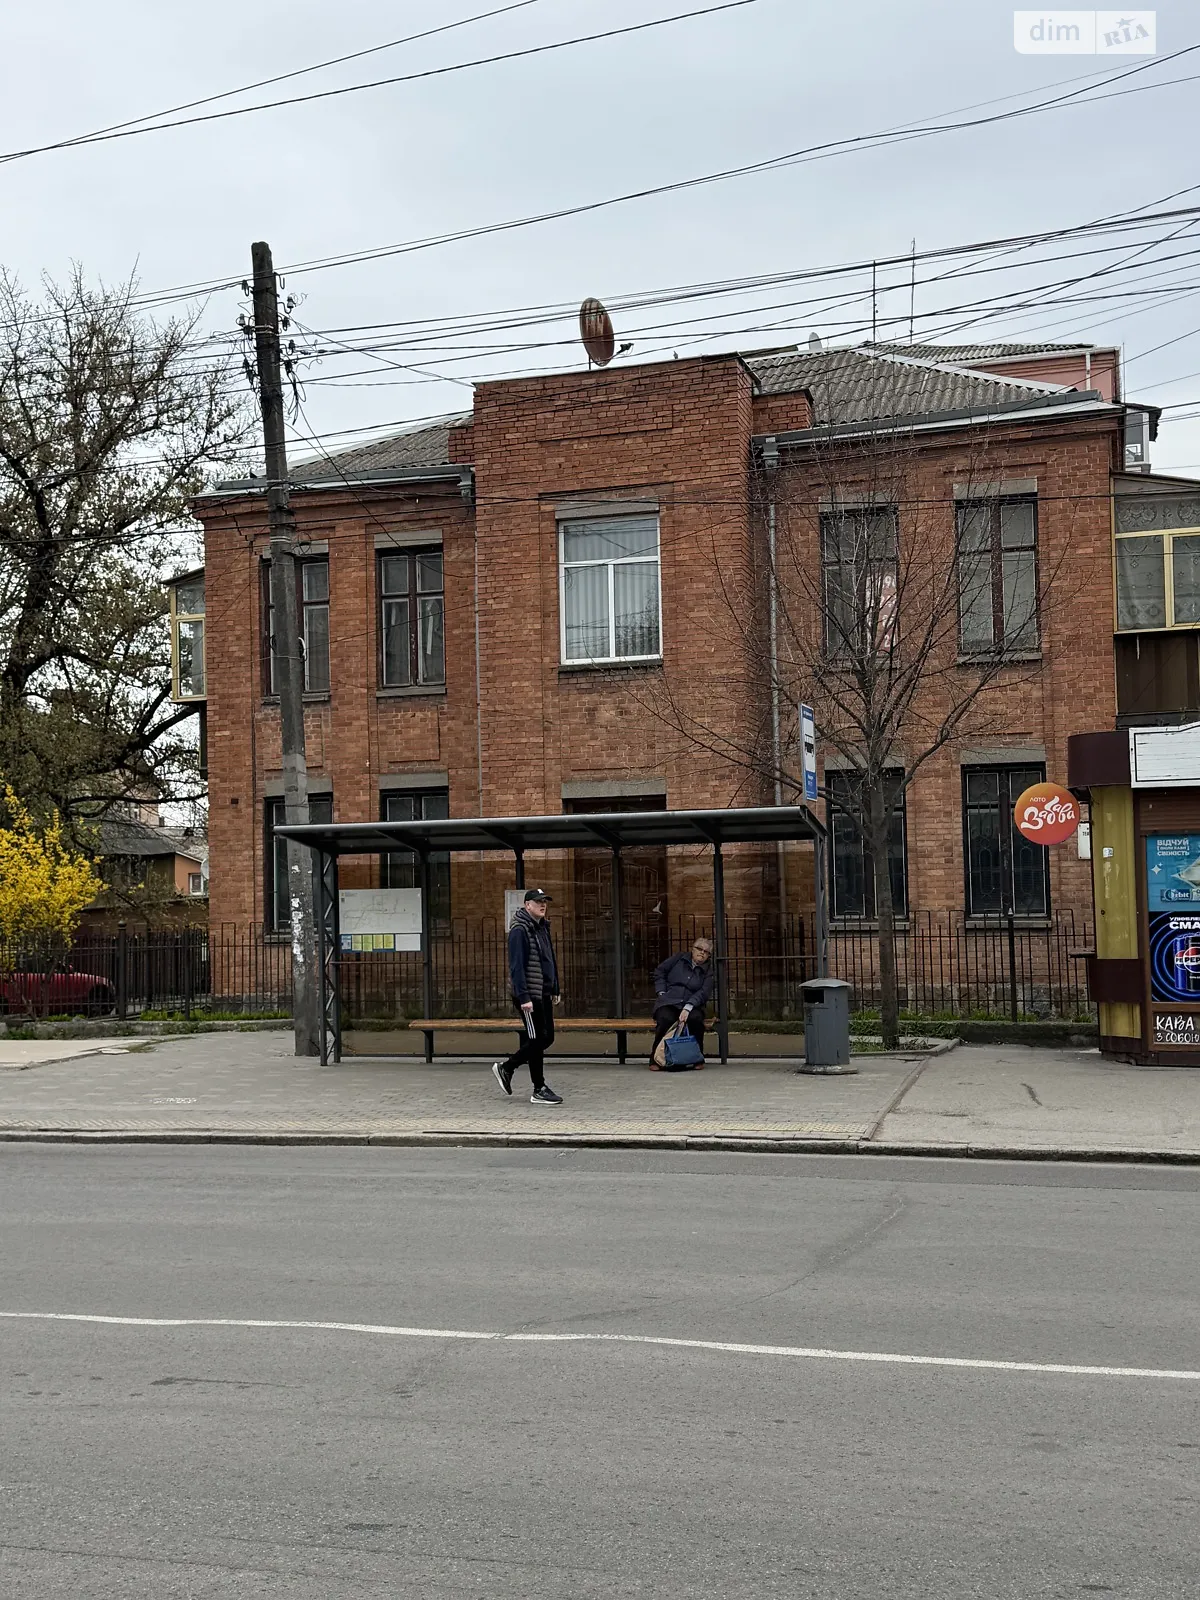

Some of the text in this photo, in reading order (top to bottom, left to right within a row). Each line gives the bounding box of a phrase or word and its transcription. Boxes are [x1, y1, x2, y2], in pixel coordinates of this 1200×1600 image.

[1020, 795, 1076, 830] Забава
[1157, 838, 1189, 846] ВІДЧУЙ
[1156, 1015, 1195, 1031] КАВА
